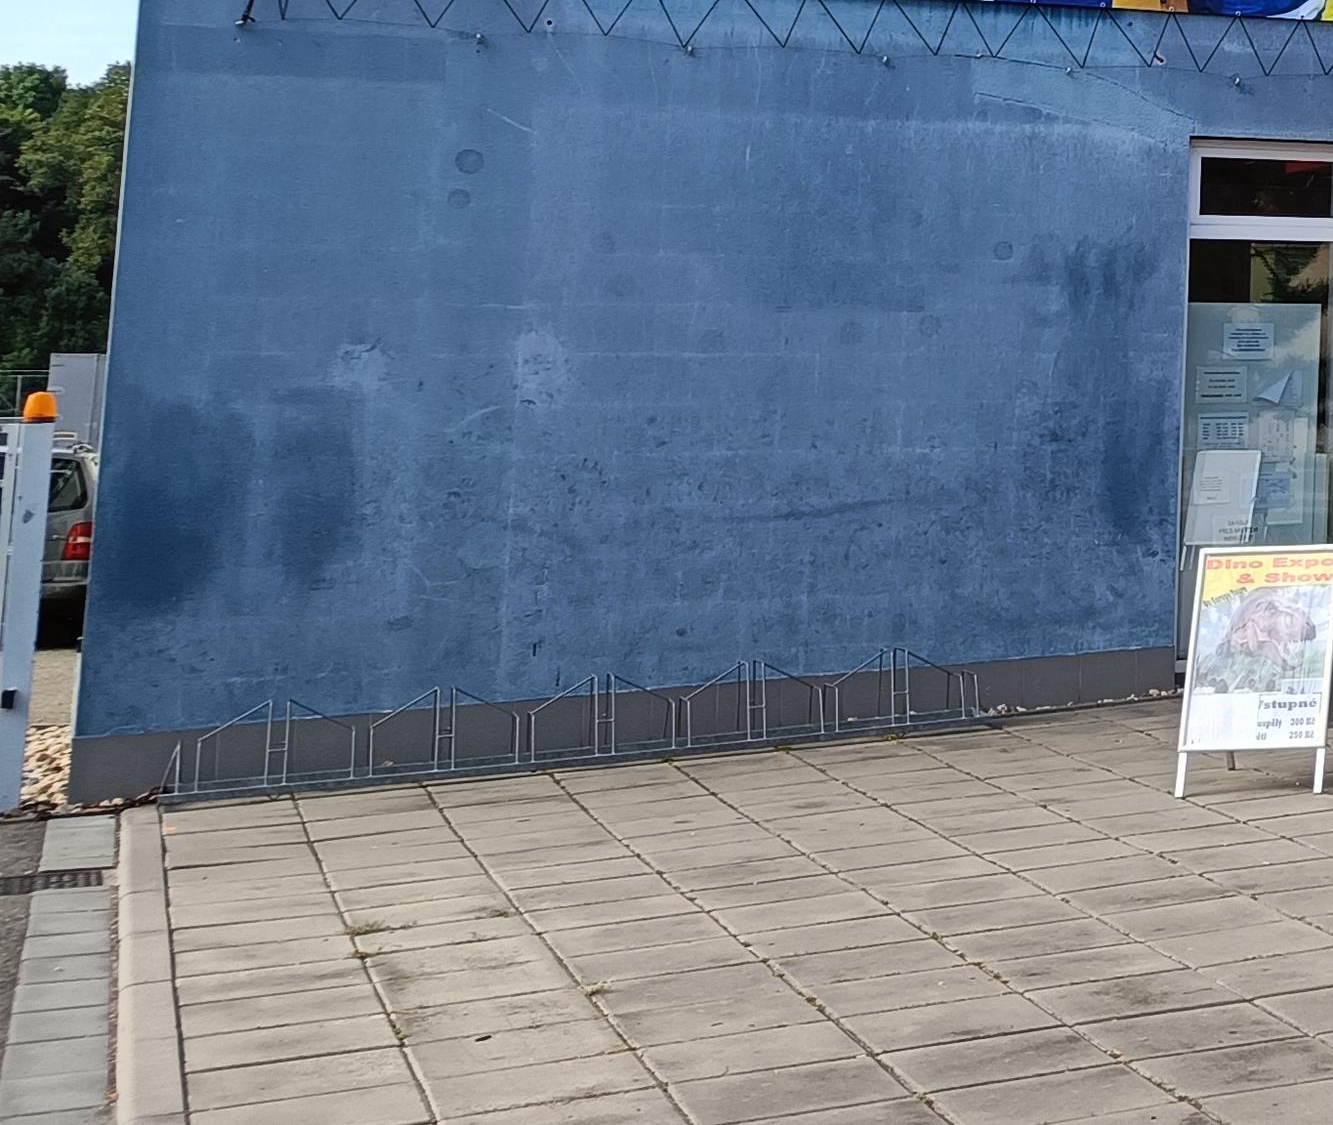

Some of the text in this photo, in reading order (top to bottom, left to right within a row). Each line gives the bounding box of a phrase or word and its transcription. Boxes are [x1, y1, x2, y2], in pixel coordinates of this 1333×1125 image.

[1206, 558, 1264, 570] Dino
[1236, 571, 1333, 584] & Show
